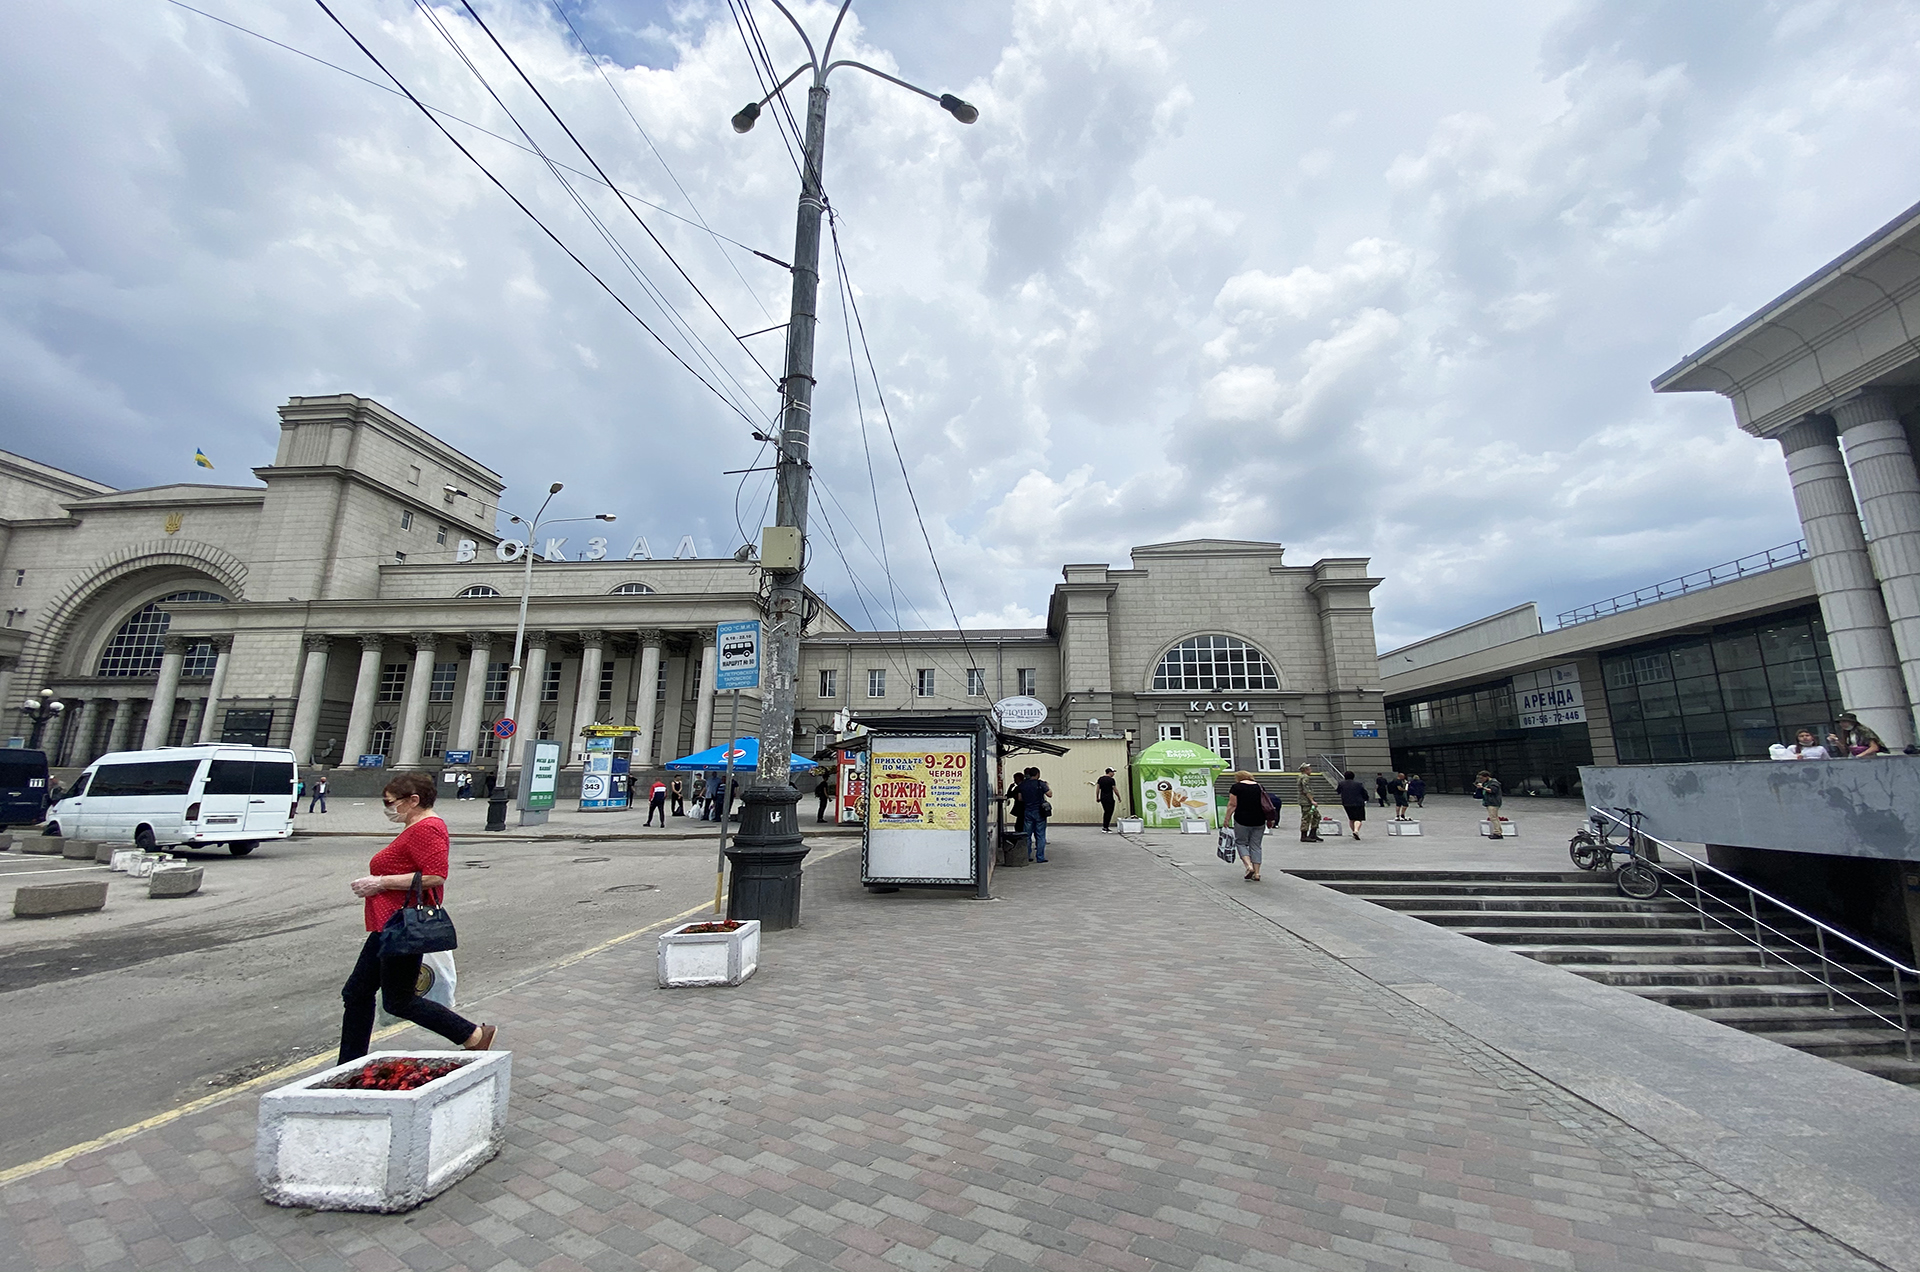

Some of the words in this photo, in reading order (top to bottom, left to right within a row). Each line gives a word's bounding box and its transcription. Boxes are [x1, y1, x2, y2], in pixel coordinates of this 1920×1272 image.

[456, 535, 699, 563] ВОКЗАЛ
[1190, 701, 1249, 712] КАСИ
[1524, 689, 1574, 709] АРЕНДА
[924, 754, 967, 769] 9-20
[873, 781, 926, 798] СВІЖИЙ
[879, 800, 924, 816] МЕД
